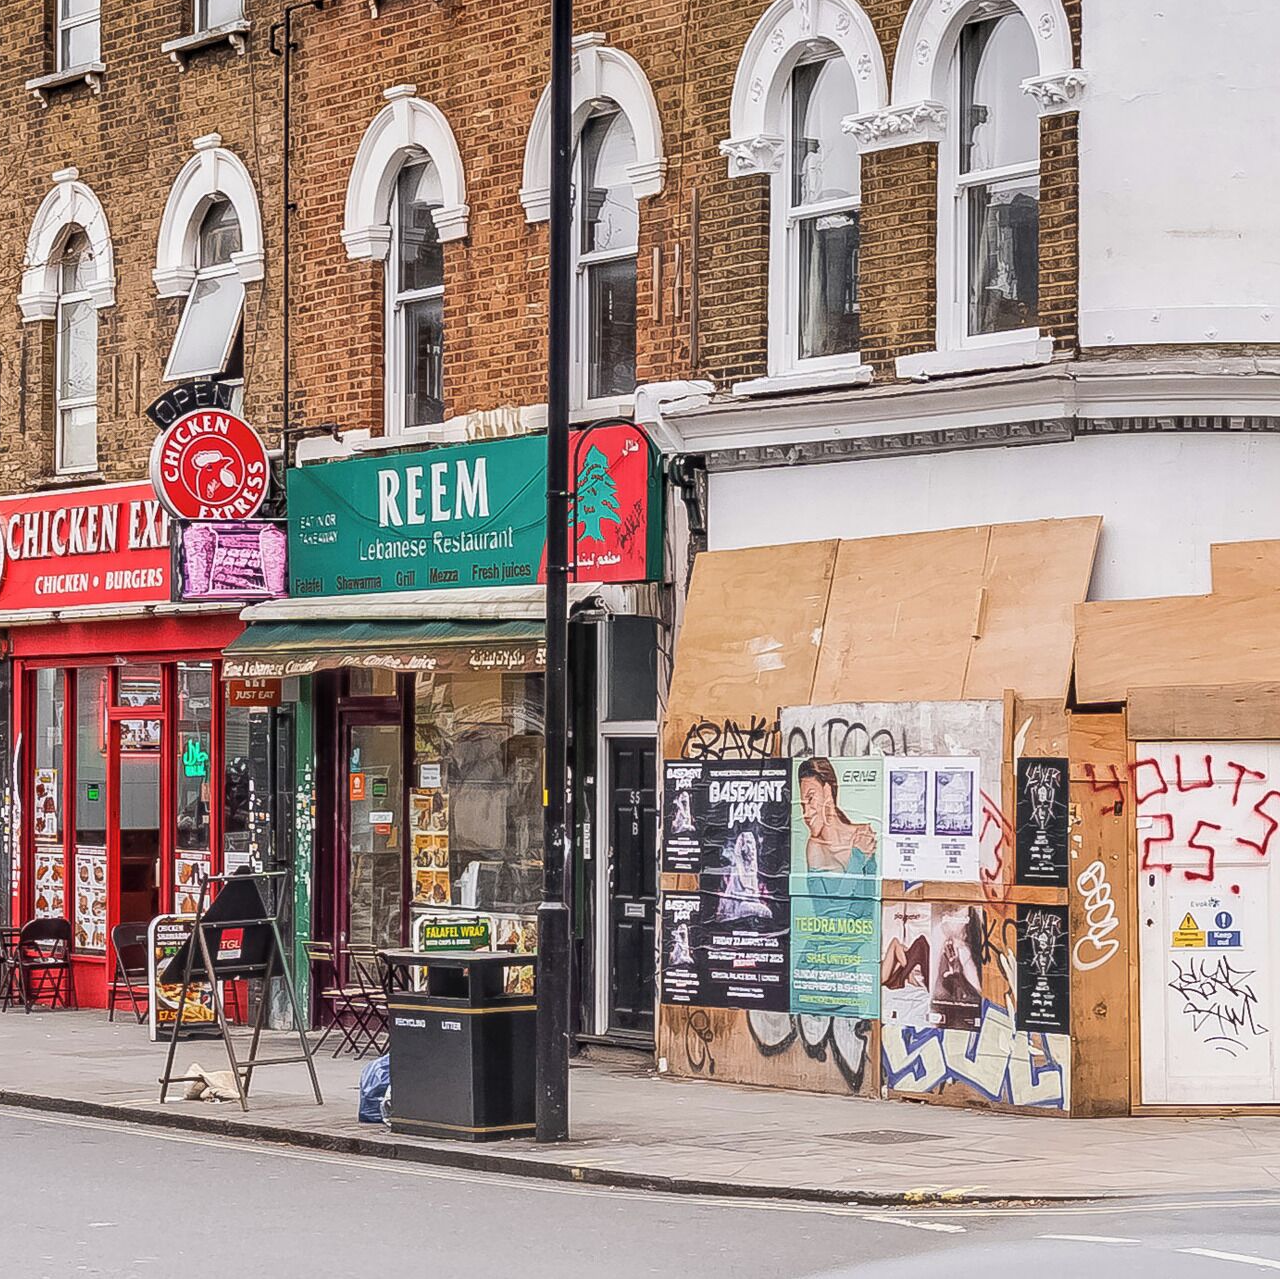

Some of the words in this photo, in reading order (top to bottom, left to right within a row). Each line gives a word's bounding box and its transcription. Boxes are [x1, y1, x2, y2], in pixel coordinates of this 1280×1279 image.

[155, 383, 234, 424] OPEN
[164, 415, 231, 483] CHICKEN
[199, 460, 264, 519] EXPRESS
[377, 457, 490, 528] REEM
[6, 504, 119, 562] CHICKEN
[358, 538, 427, 562] Lebanese
[432, 526, 513, 554] Restaurant
[35, 573, 89, 595] CHICKEN
[105, 568, 163, 591] BURGERS
[295, 575, 324, 594] Falafel
[336, 575, 382, 593] Shawarma
[396, 569, 415, 587] Grill
[429, 567, 459, 584] Mezza
[471, 562, 500, 582] Fresh
[501, 561, 531, 583] juices
[407, 654, 437, 670] Juice
[235, 690, 256, 701] JUST
[258, 690, 276, 700] EAT
[709, 779, 787, 803] BASEMENT
[631, 822, 639, 836] B
[727, 802, 763, 829] JAXX
[425, 926, 459, 938] FALAFEL
[461, 926, 486, 937] WRAP
[795, 917, 836, 934] TEEDRA
[837, 919, 874, 935] MOSES
[221, 940, 241, 949] TGL
